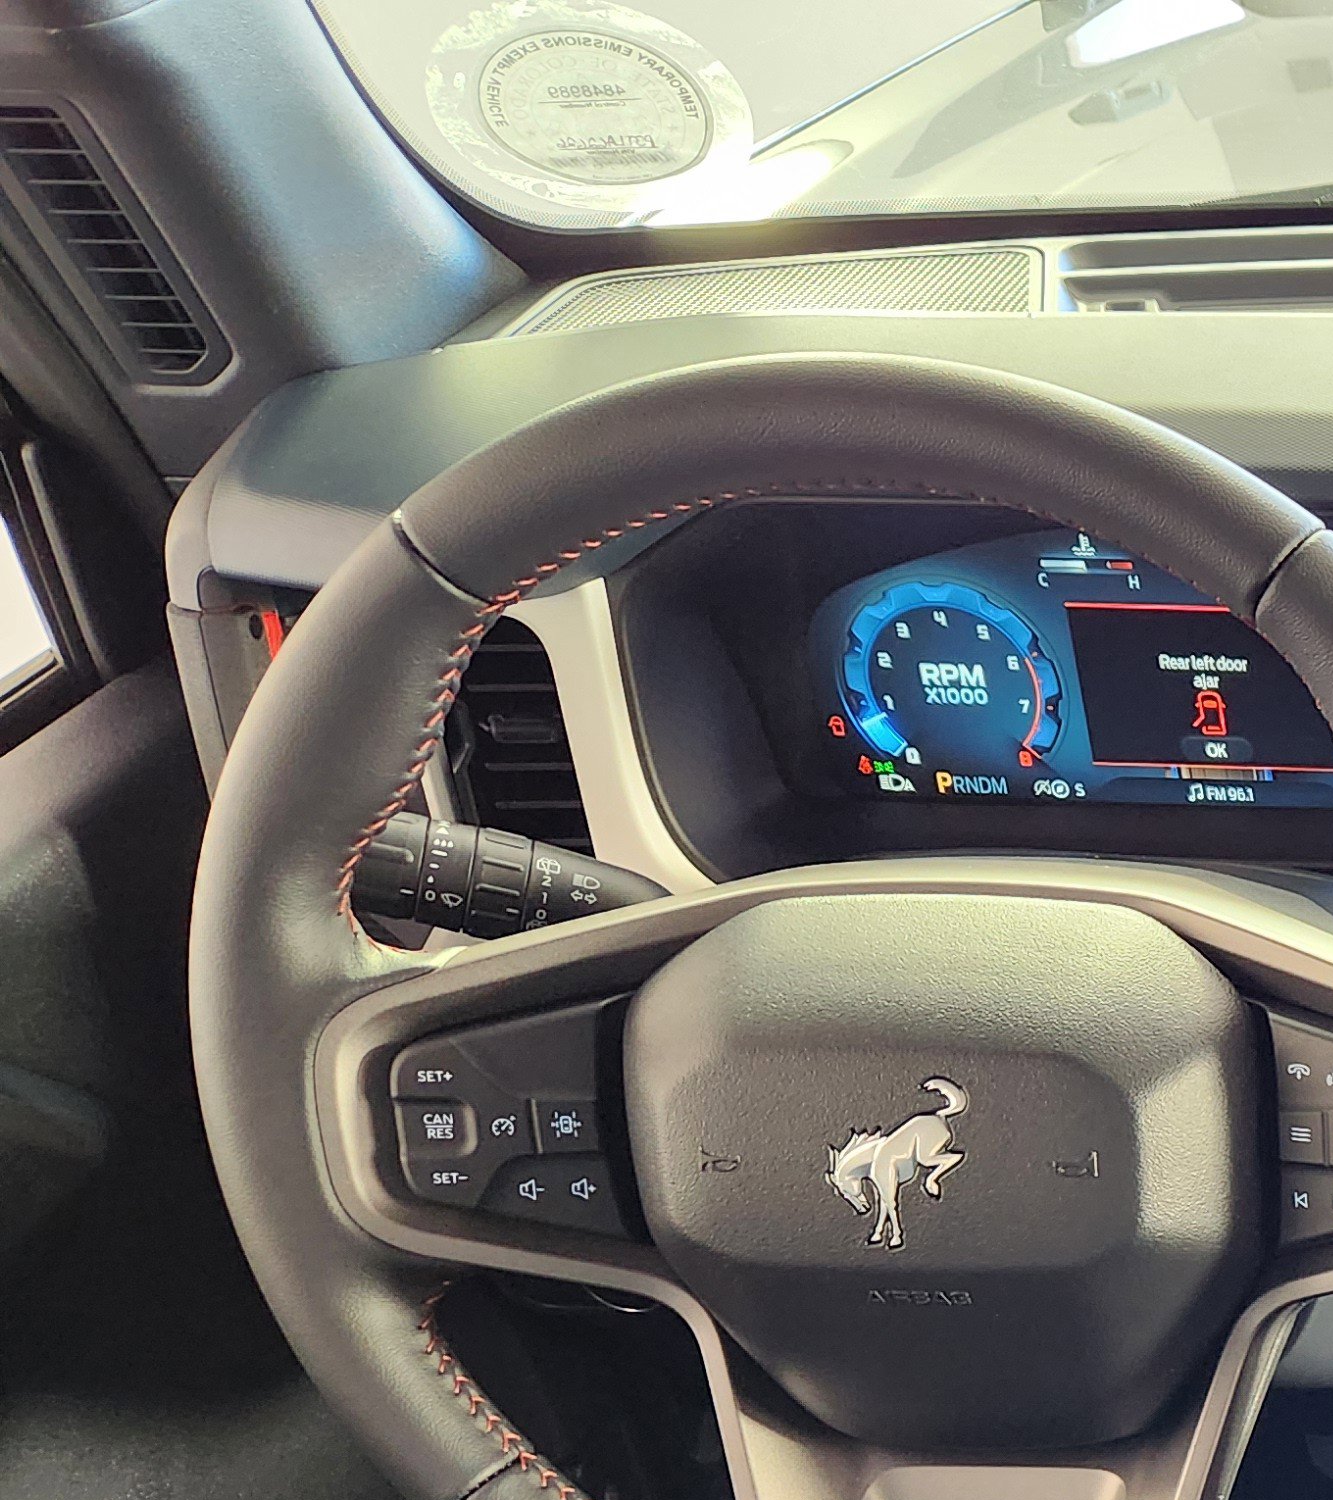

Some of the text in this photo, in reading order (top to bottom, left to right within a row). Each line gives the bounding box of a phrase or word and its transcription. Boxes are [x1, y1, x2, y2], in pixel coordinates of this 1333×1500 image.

[1038, 572, 1049, 588] C
[1127, 575, 1141, 590] H
[933, 610, 948, 627] 4
[895, 622, 911, 639] 3
[976, 624, 990, 640] 5
[877, 652, 893, 668] 2
[1007, 655, 1020, 671] 6
[1158, 653, 1248, 673] Rear left door
[919, 662, 987, 688] RPM
[1193, 674, 1220, 690] ajar
[883, 694, 895, 711] 1
[924, 688, 989, 705] X1000
[1019, 699, 1031, 713] 7
[1204, 742, 1229, 760] OK
[1075, 782, 1086, 798] S
[1206, 785, 1255, 803] FM 96.1
[541, 875, 552, 888] 2
[417, 1070, 453, 1083] SET+
[422, 1113, 454, 1125] CAN
[427, 1128, 454, 1139] RES
[432, 1173, 469, 1184] SET-
